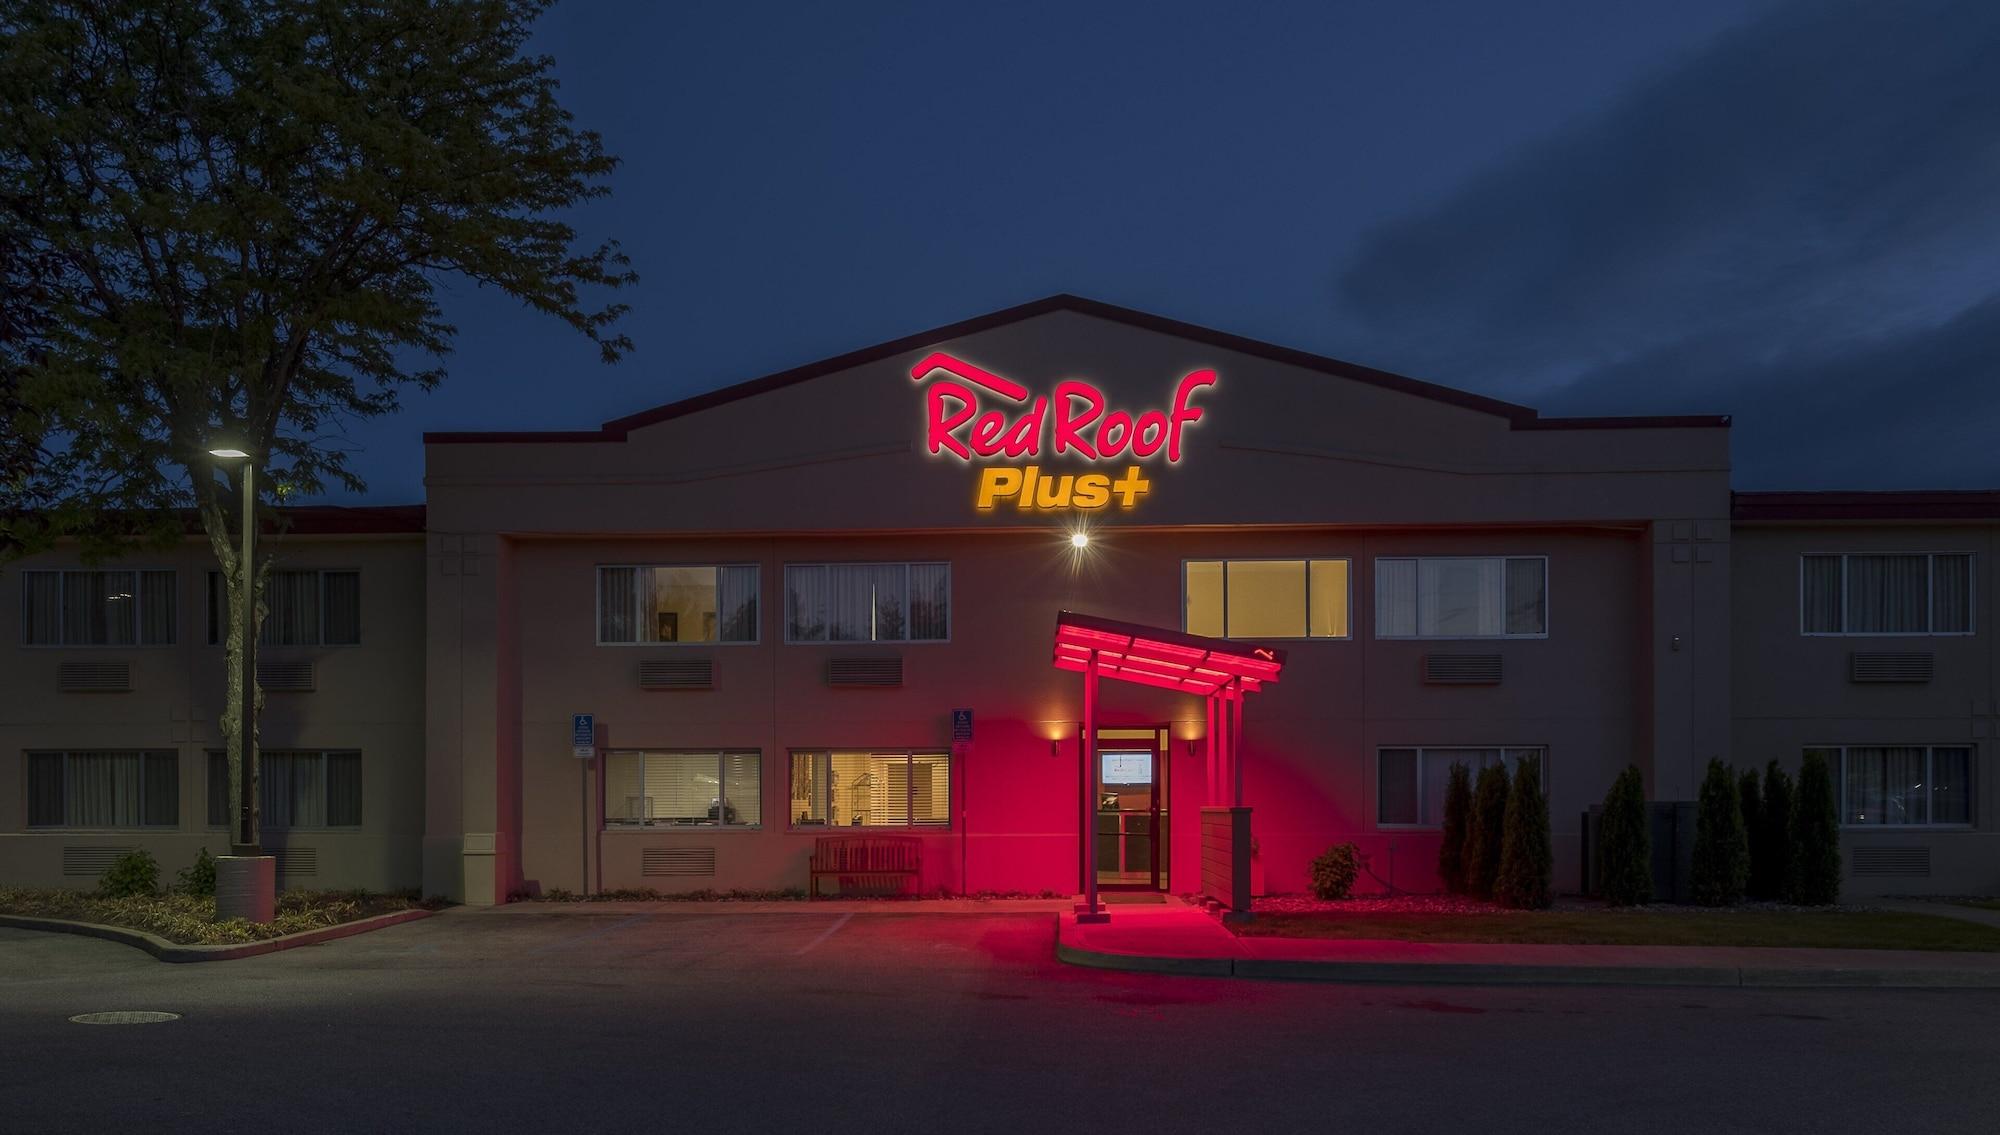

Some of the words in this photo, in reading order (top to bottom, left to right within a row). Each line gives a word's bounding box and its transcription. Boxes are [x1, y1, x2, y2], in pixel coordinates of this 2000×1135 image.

[928, 381, 1047, 460] Red
[1055, 369, 1217, 462] Roof
[977, 466, 1150, 508] Plus+
